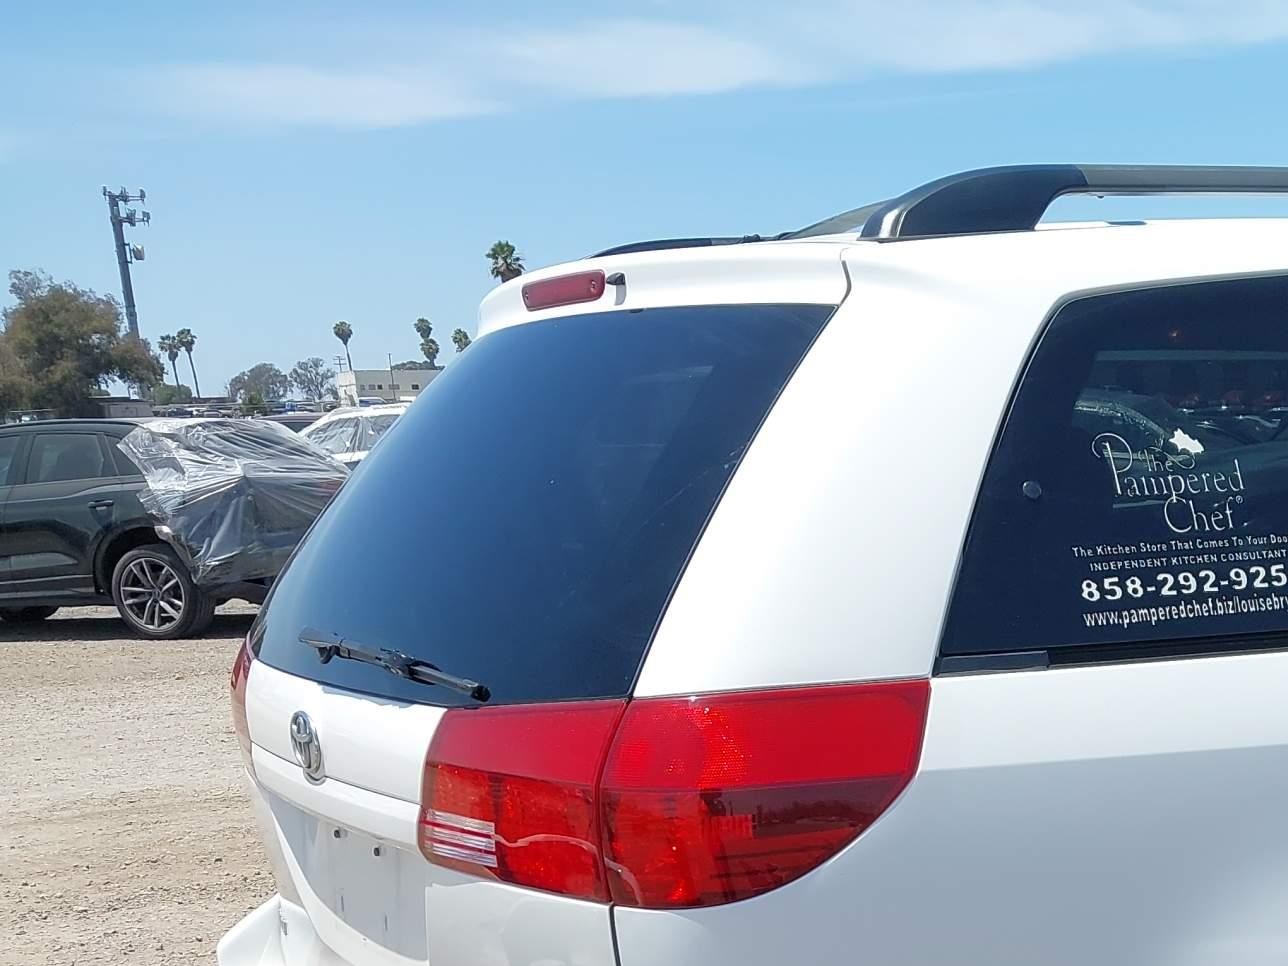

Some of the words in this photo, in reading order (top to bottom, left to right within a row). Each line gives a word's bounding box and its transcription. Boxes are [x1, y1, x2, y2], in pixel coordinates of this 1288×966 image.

[1092, 433, 1246, 503] Pampered
[1138, 447, 1181, 472] The
[1072, 546, 1094, 558] The
[1095, 544, 1137, 556] Kitchen
[1140, 542, 1168, 553] Store
[1170, 540, 1194, 550] That
[1196, 538, 1229, 549] Comes
[1231, 536, 1244, 546] To
[1245, 535, 1268, 545] Your
[1089, 557, 1168, 572] INDEPENDENT
[1171, 553, 1218, 567] KITCHEN
[1220, 549, 1288, 562] CONSULTANT
